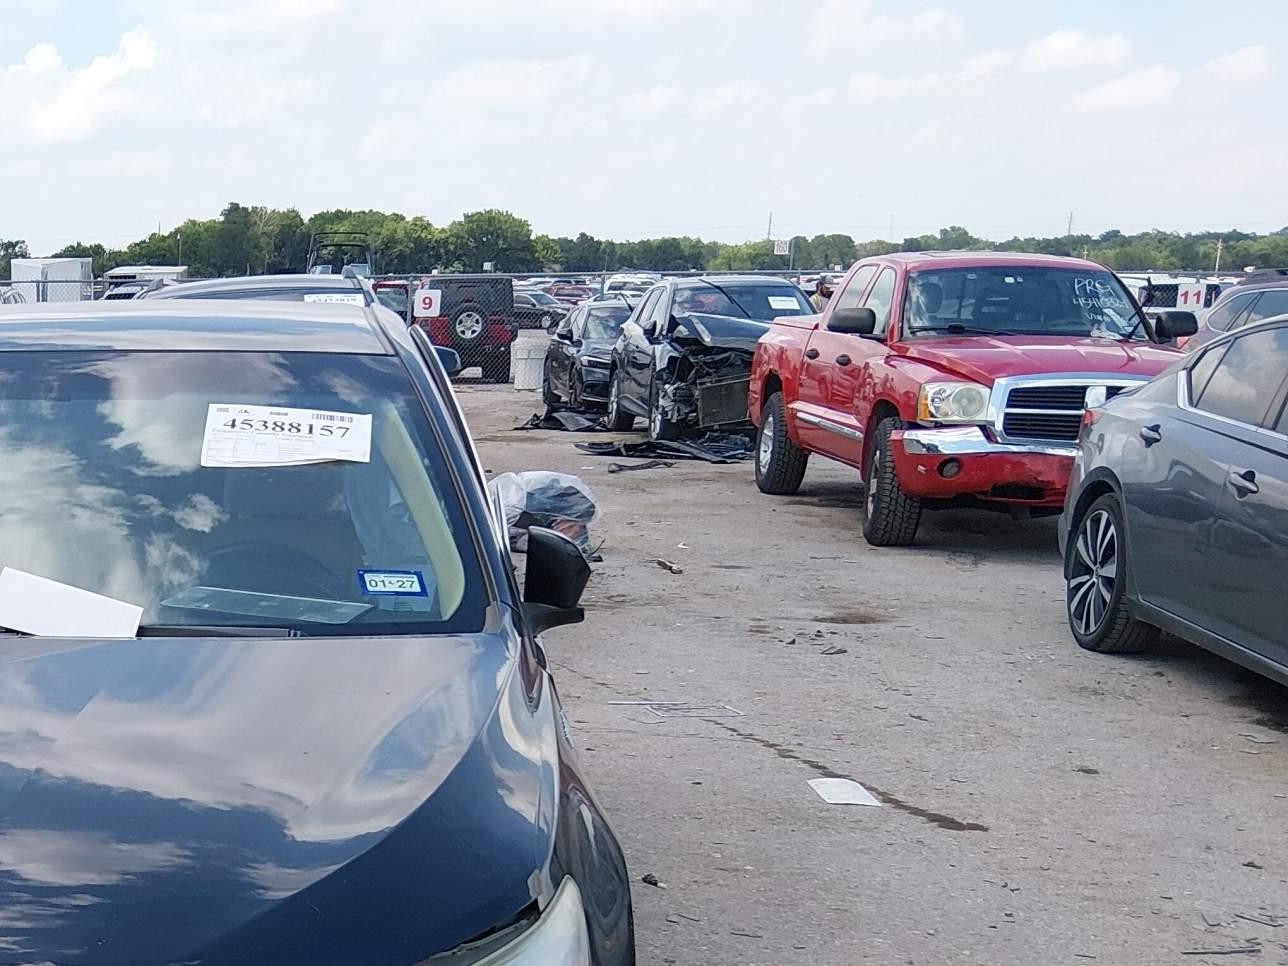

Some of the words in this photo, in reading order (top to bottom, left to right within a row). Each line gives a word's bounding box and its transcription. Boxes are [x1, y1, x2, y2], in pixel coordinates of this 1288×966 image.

[422, 296, 433, 310] 9
[1180, 290, 1201, 304] 11
[223, 417, 351, 438] 45388157
